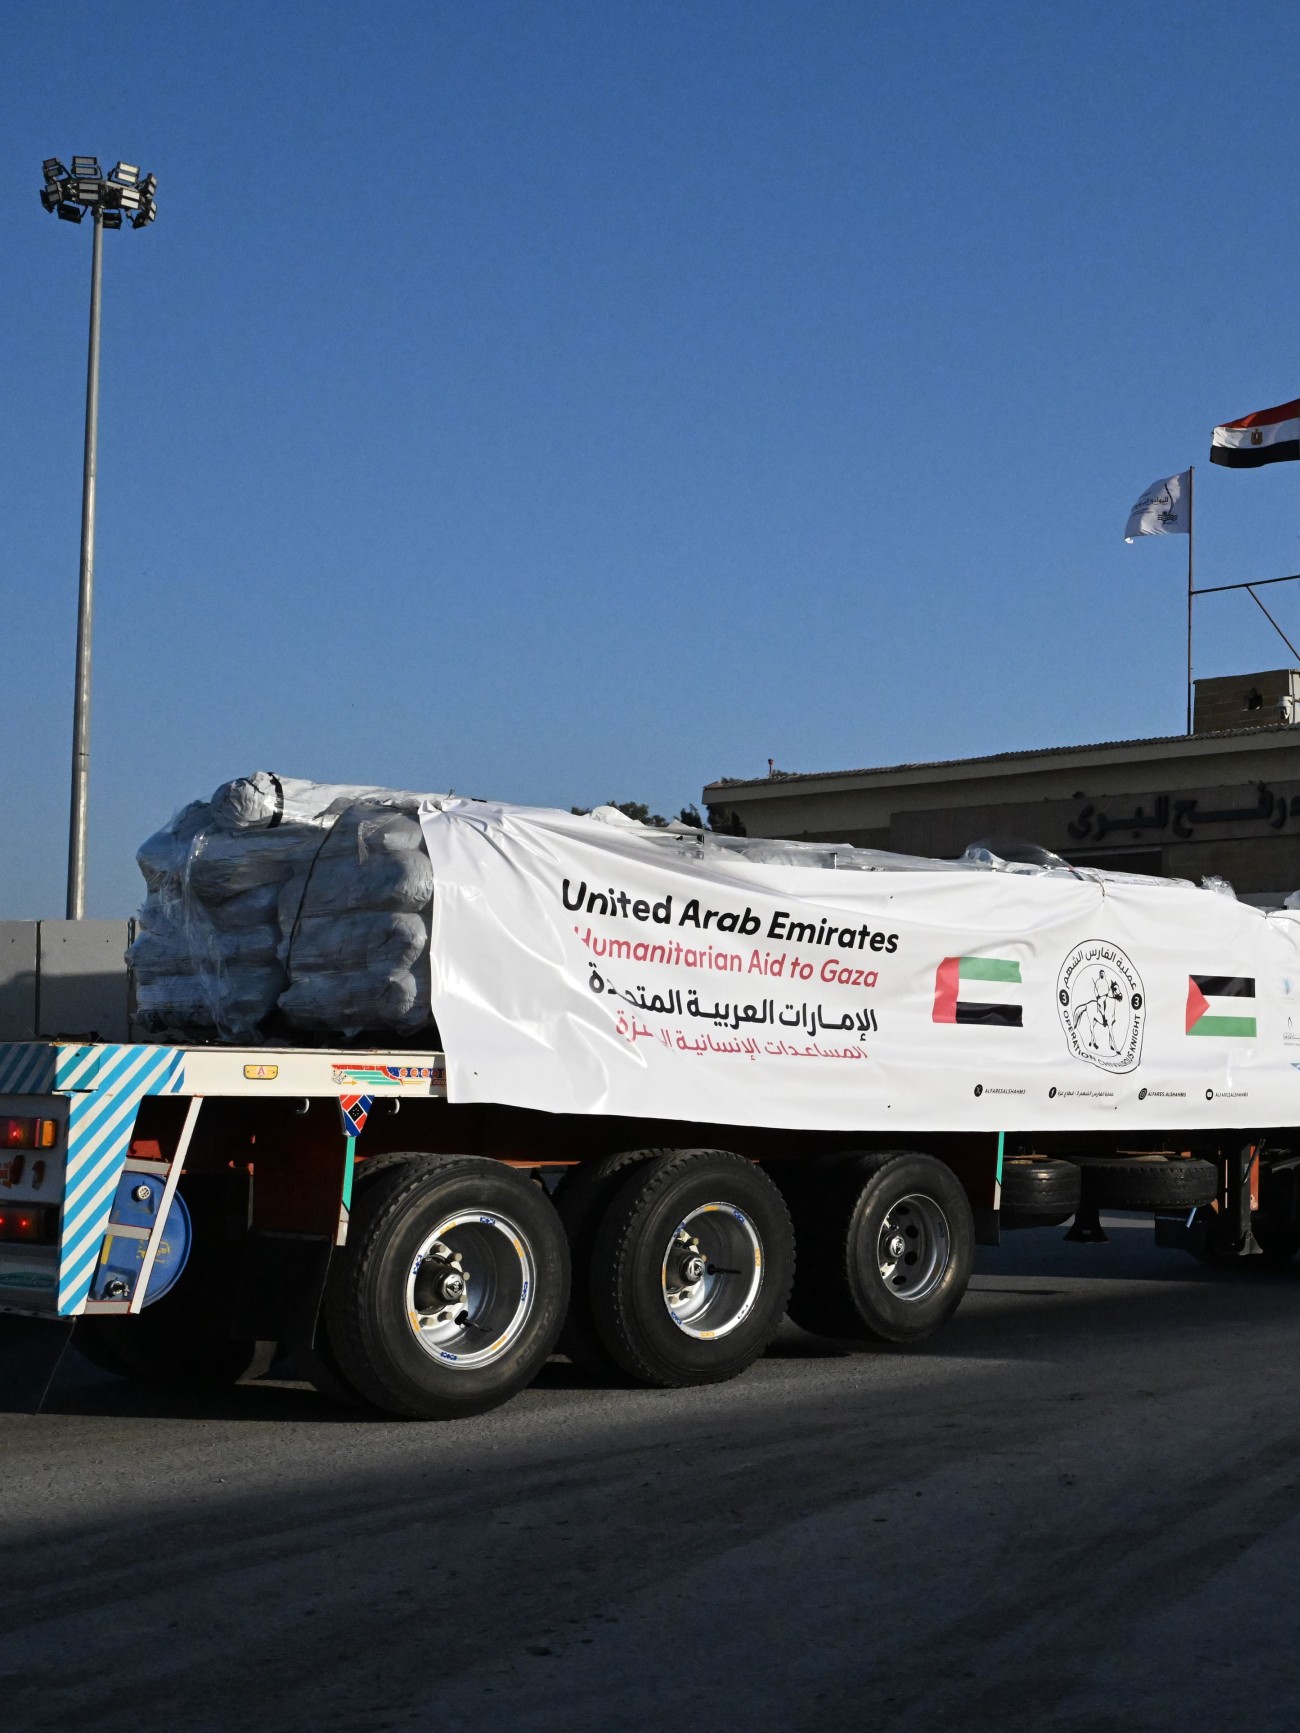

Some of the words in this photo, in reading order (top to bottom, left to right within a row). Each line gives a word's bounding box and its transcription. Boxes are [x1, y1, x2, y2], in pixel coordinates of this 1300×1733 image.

[1172, 782, 1287, 838] رفح
[562, 878, 673, 924] United
[679, 899, 761, 936] Arab
[767, 911, 900, 954] Emirates
[748, 948, 786, 978] Aid
[789, 954, 814, 982] to
[820, 958, 879, 988] Gaza
[1063, 950, 1084, 989] الشهم
[1085, 947, 1117, 961] الفارس
[1116, 957, 1137, 991] عملية
[687, 989, 774, 1029] العربية
[779, 1003, 878, 1041] الإمارات
[676, 1030, 761, 1061] الإنسانية
[764, 1040, 868, 1060] المساعدات
[1063, 1010, 1096, 1061] OPERATION
[1129, 1014, 1141, 1053] KNIGHT
